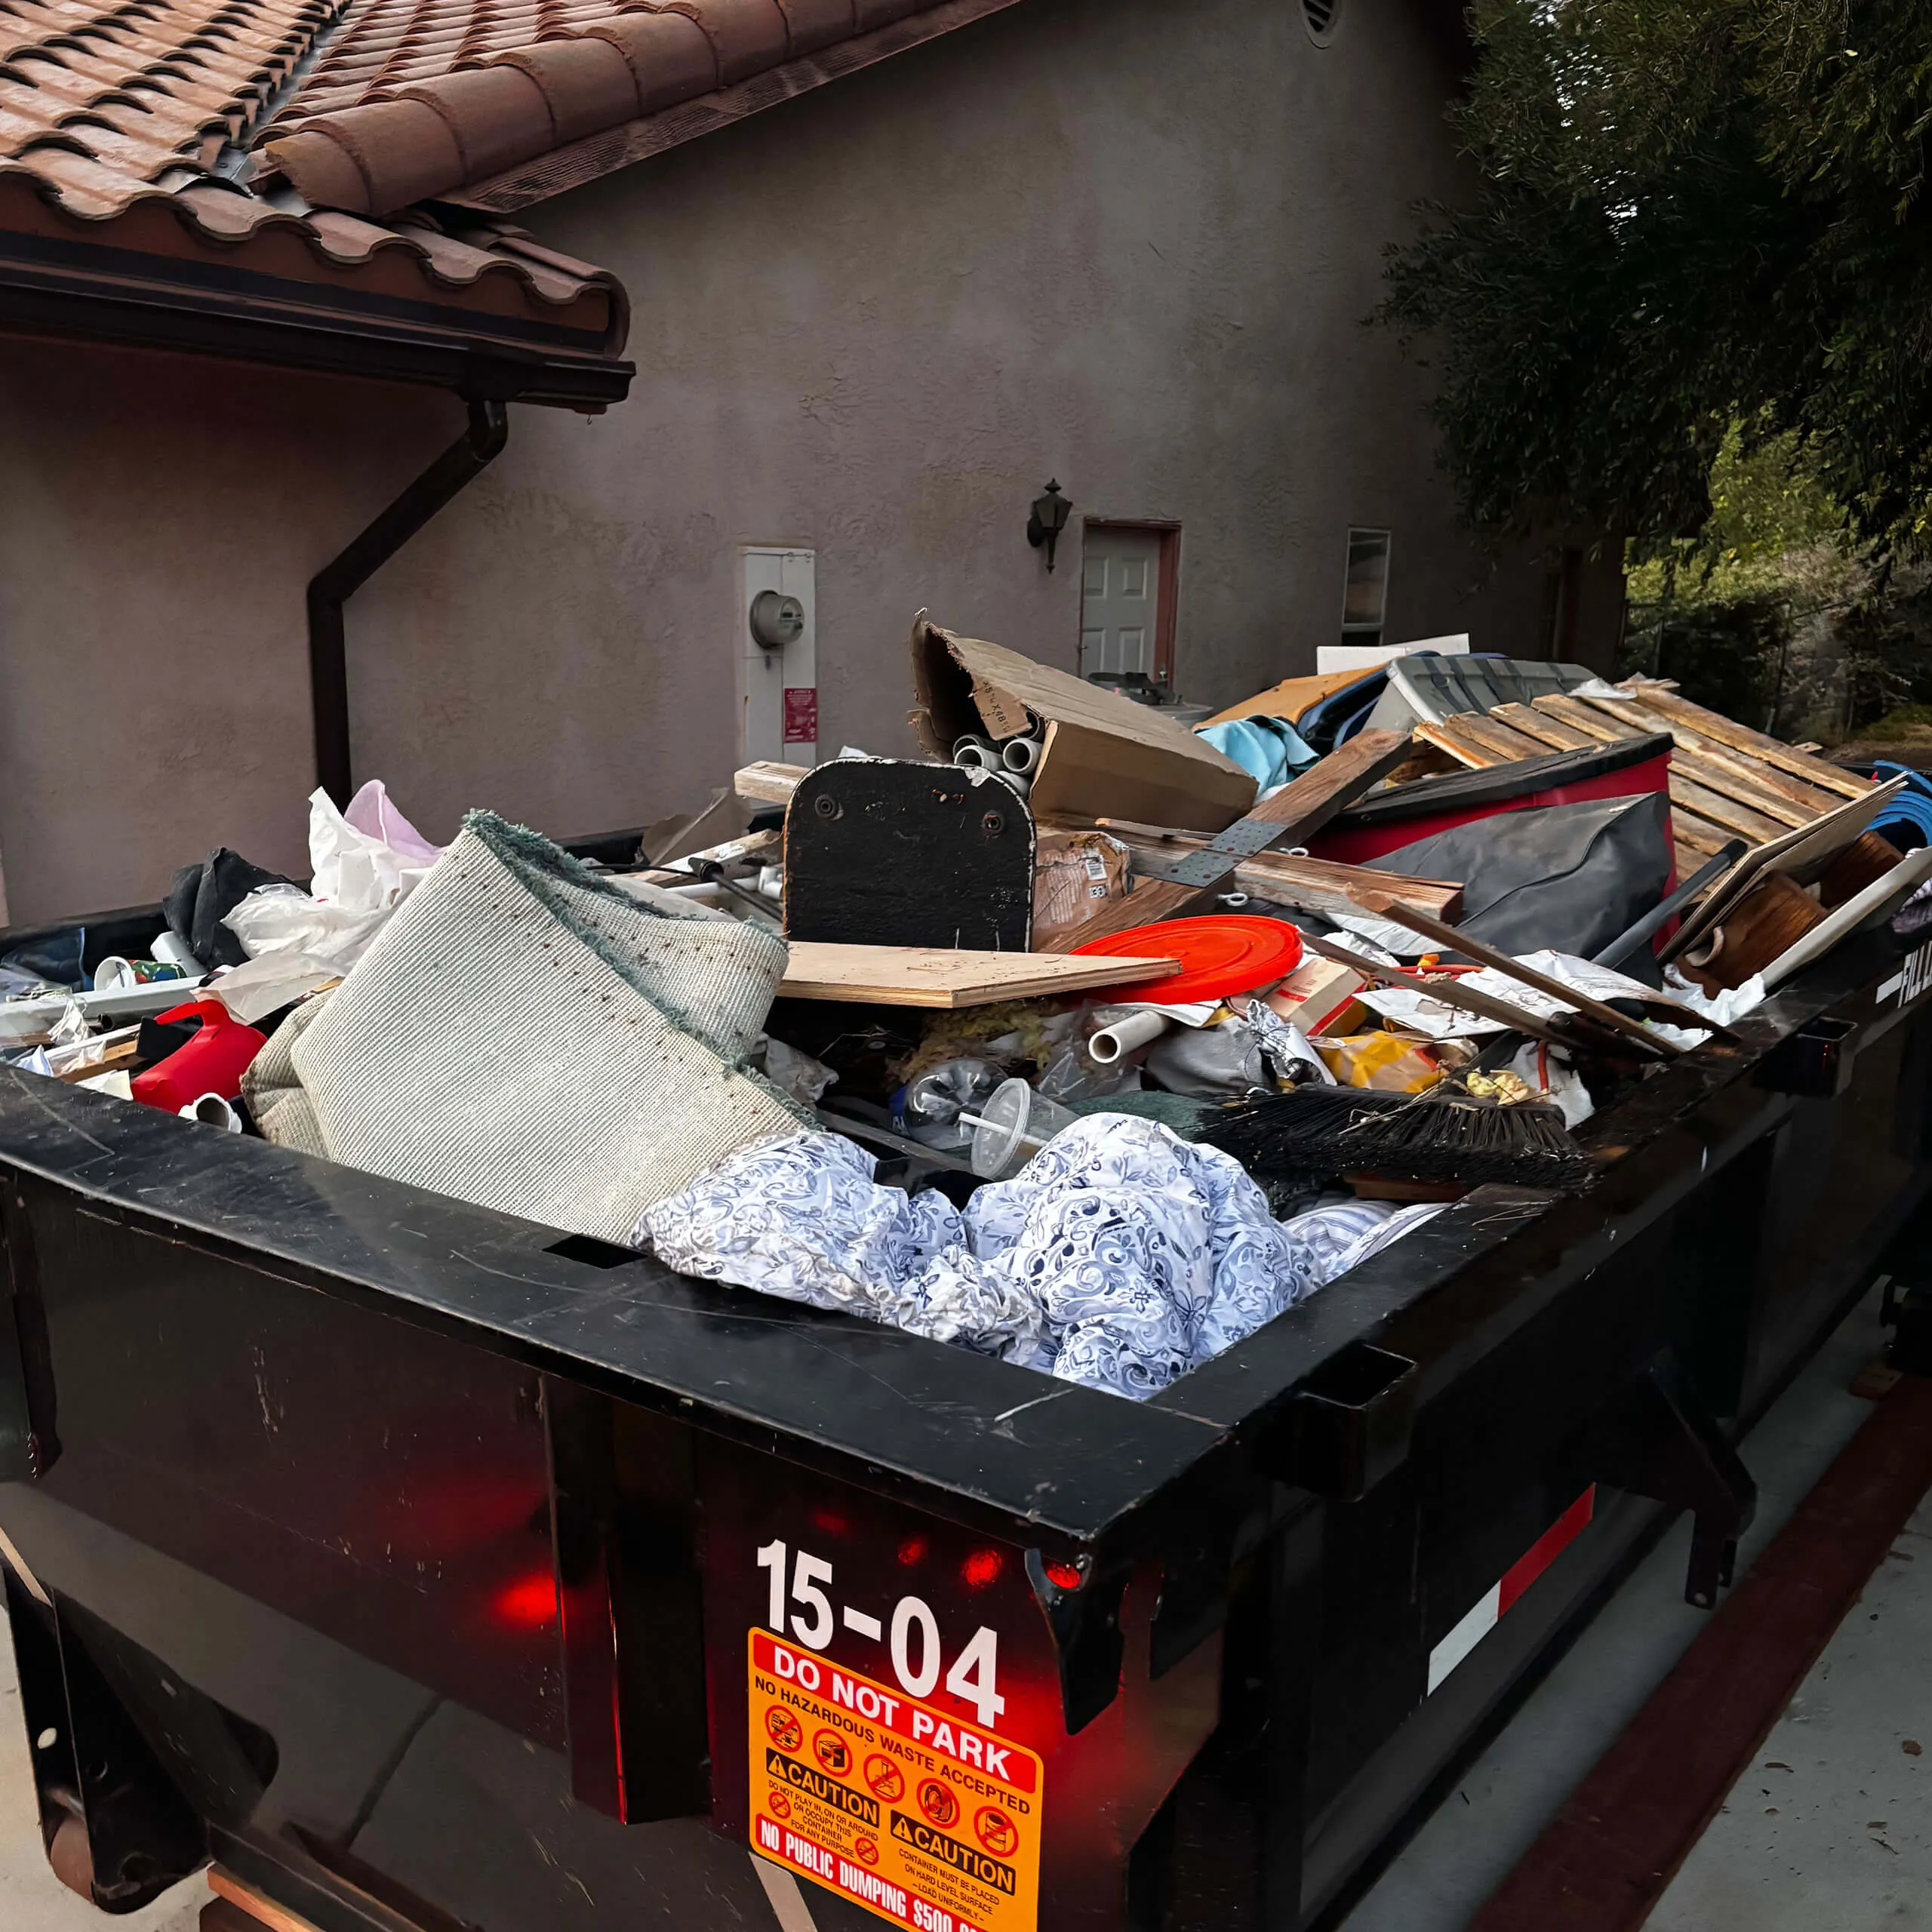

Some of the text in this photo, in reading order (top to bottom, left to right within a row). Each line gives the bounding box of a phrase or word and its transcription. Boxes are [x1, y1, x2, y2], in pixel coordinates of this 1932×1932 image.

[757, 1539, 1004, 1728] 15-04
[774, 1645, 1011, 1781] DO NOT PARK
[755, 1675, 1030, 1814] NO HAZARDOUS WASTE ACCEPTED
[768, 1780, 778, 1790] DO
[780, 1786, 793, 1798] NOT
[795, 1793, 812, 1807] PLAY
[823, 1808, 835, 1820] ON
[836, 1814, 847, 1826] OR
[848, 1821, 878, 1841] AROUND
[787, 1764, 878, 1825] CAUTION
[793, 1802, 852, 1838] OR OCCUPY THIS
[791, 1819, 855, 1858] FOR ANY PURPOSE
[802, 1816, 842, 1842] CONTAINER
[914, 1826, 1014, 1892] CAUTION
[761, 1820, 952, 1932] NO PUBLIC DUMPING $500
[899, 1848, 1000, 1906] CONTAINER MUST BE PLACED
[905, 1864, 993, 1915] ON HARD LEVEL SURFACE
